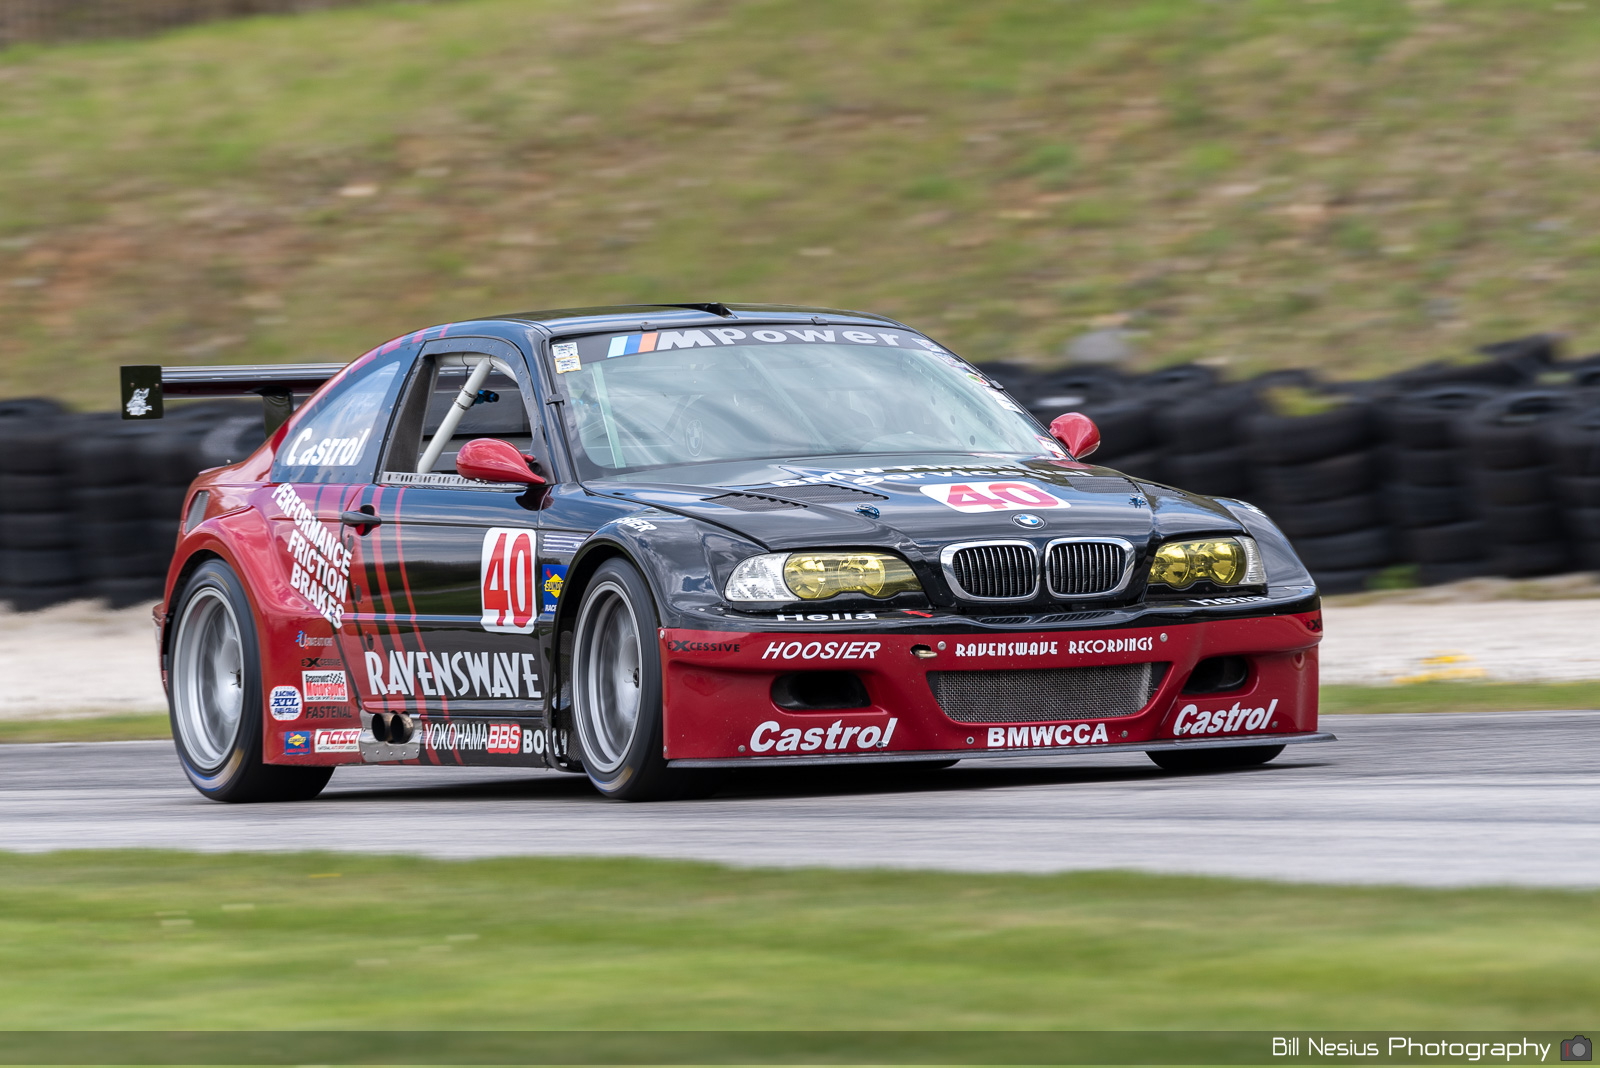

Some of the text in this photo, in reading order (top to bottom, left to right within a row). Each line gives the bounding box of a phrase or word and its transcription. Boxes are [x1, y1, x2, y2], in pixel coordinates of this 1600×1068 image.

[286, 427, 371, 466] Castrol
[771, 464, 1094, 487] BMW Finanial
[853, 469, 1051, 487] Service
[946, 483, 1059, 510] 40
[271, 482, 352, 577] PERFORMANCE
[287, 529, 348, 604] FRICTION
[483, 532, 534, 628] 40
[290, 562, 345, 629] BRAKES
[776, 613, 878, 622] Hella
[762, 641, 882, 660] HOOSIER
[955, 636, 1153, 657] RAVENSWAVE RECORDINGS
[364, 650, 542, 698] RAVENSWAVE
[271, 697, 300, 707] ATL
[305, 705, 353, 719] FASTENAL
[1173, 698, 1279, 736] Castrol
[425, 723, 489, 751] YOKOHAMA
[489, 724, 521, 750] BBS
[750, 717, 899, 753] Castrol
[987, 723, 1109, 748] BMWCCA
